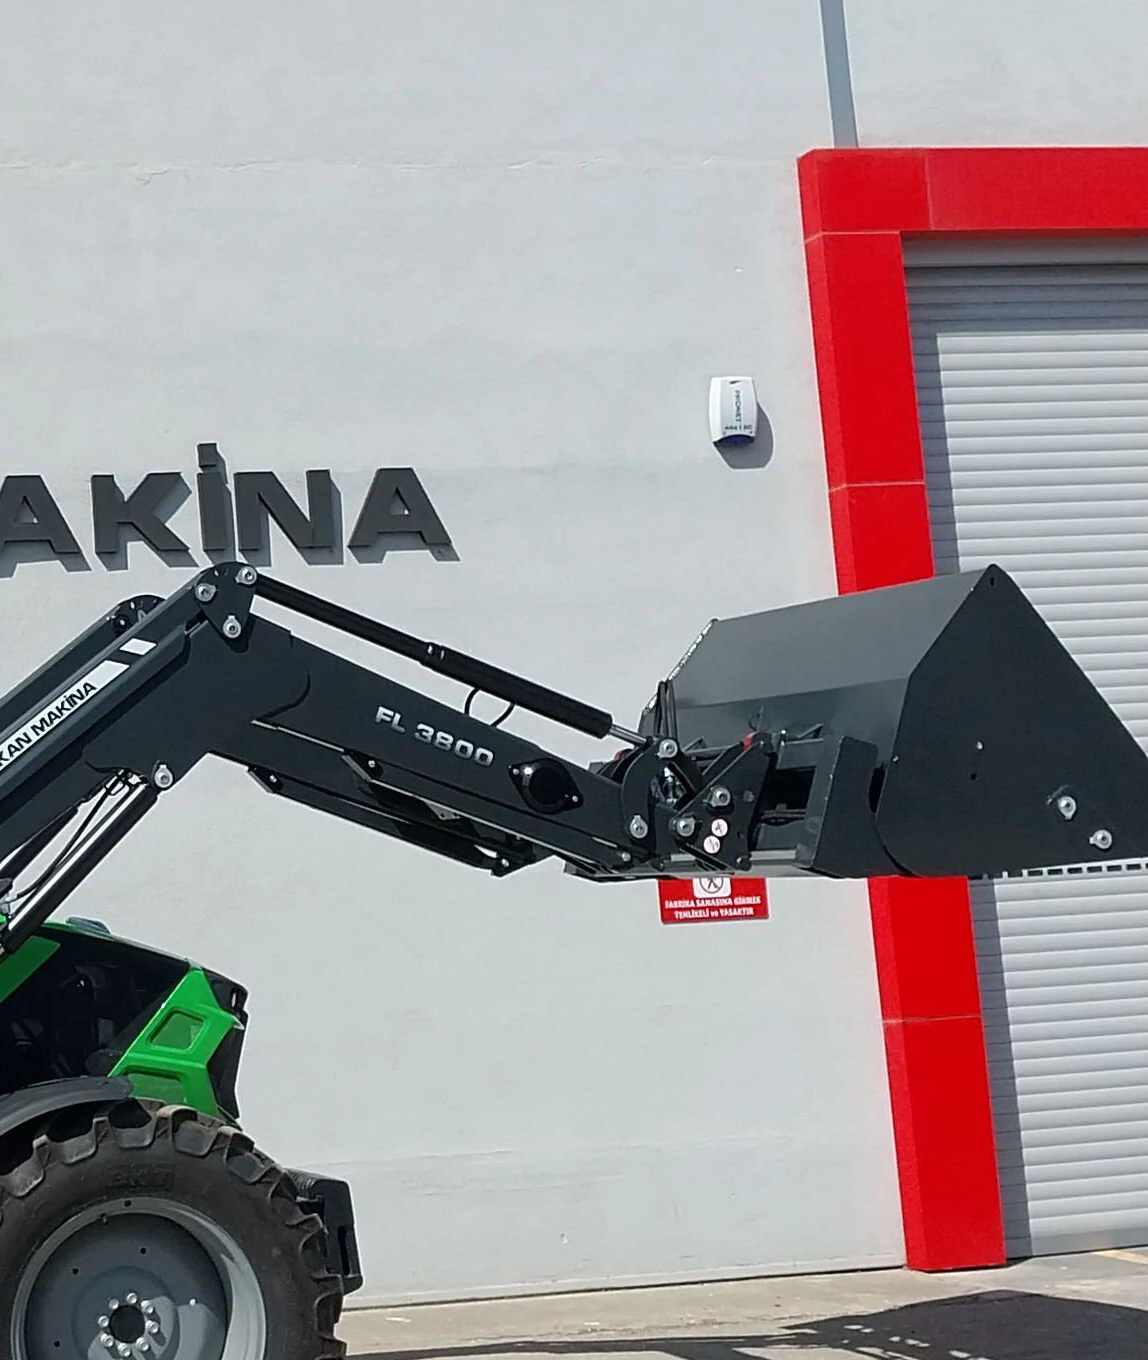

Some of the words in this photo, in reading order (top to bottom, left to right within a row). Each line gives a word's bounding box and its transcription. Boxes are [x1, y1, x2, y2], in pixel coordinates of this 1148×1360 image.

[30, 681, 98, 737] MAKİNA
[374, 705, 406, 733] FL
[413, 722, 495, 768] 3800
